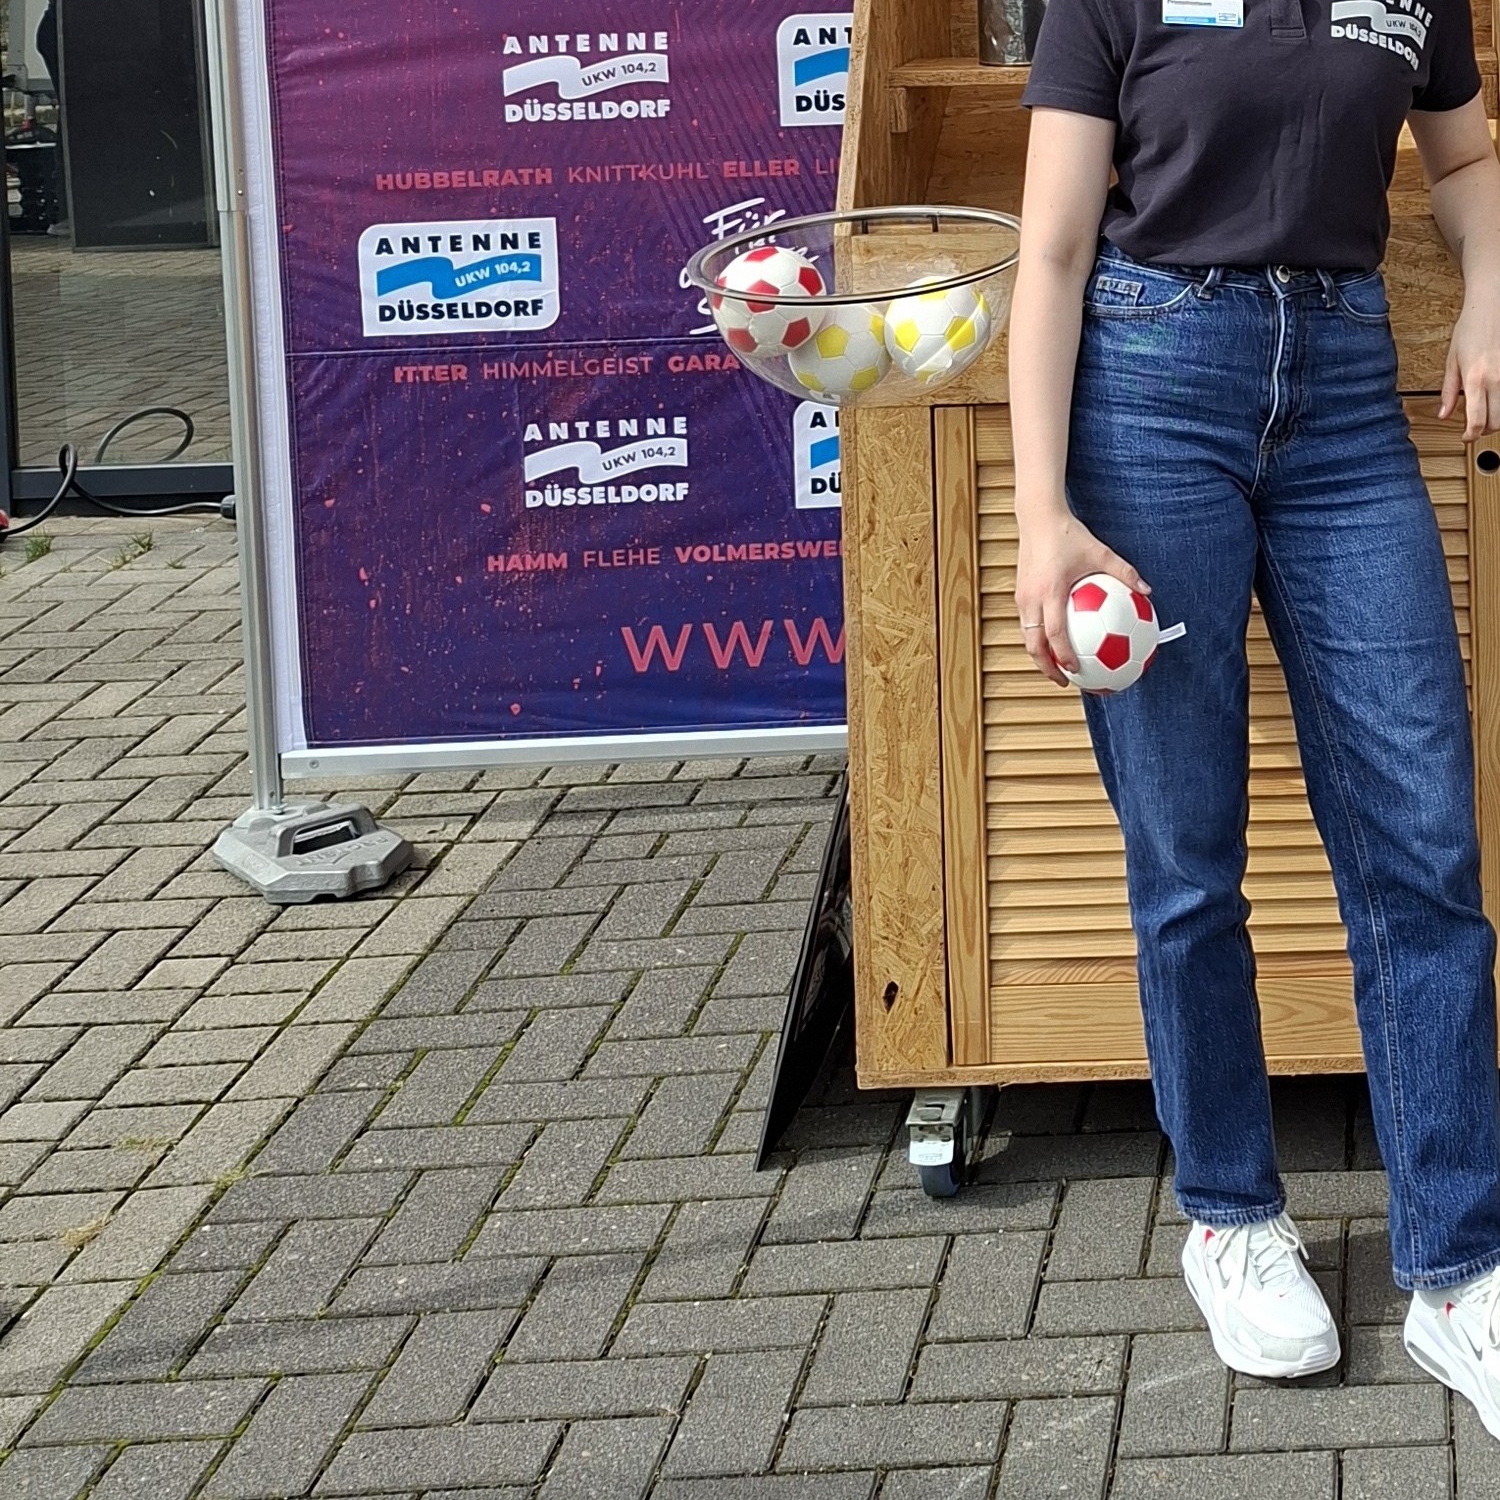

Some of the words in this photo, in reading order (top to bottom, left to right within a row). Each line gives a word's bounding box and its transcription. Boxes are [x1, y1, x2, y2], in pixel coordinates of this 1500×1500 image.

[1385, 19, 1407, 29] UKW
[502, 31, 669, 55] ANTENNE
[580, 68, 617, 88] UKW
[620, 61, 658, 77] 104,2
[504, 98, 671, 123] DÜSSELDORF
[375, 169, 554, 191] HUBBELRATH
[567, 161, 706, 185] KNITTKUHL
[722, 159, 801, 179] ELLER
[374, 231, 542, 257] ANTENNE
[454, 268, 491, 289] UKW
[493, 260, 532, 276] 104,2
[377, 298, 545, 324] DÜSSELDORF
[394, 364, 468, 384] ITTER
[482, 355, 653, 381] HIMMELGEIST
[667, 354, 742, 375] GARA
[523, 416, 689, 443] ANTENNE
[601, 451, 638, 472] UKW
[641, 445, 677, 461] 104,2
[525, 482, 690, 509] DÜSSELDORF
[486, 552, 568, 573] HAMM
[582, 547, 661, 567] FLEHE
[674, 541, 842, 564] VOLMERSWE
